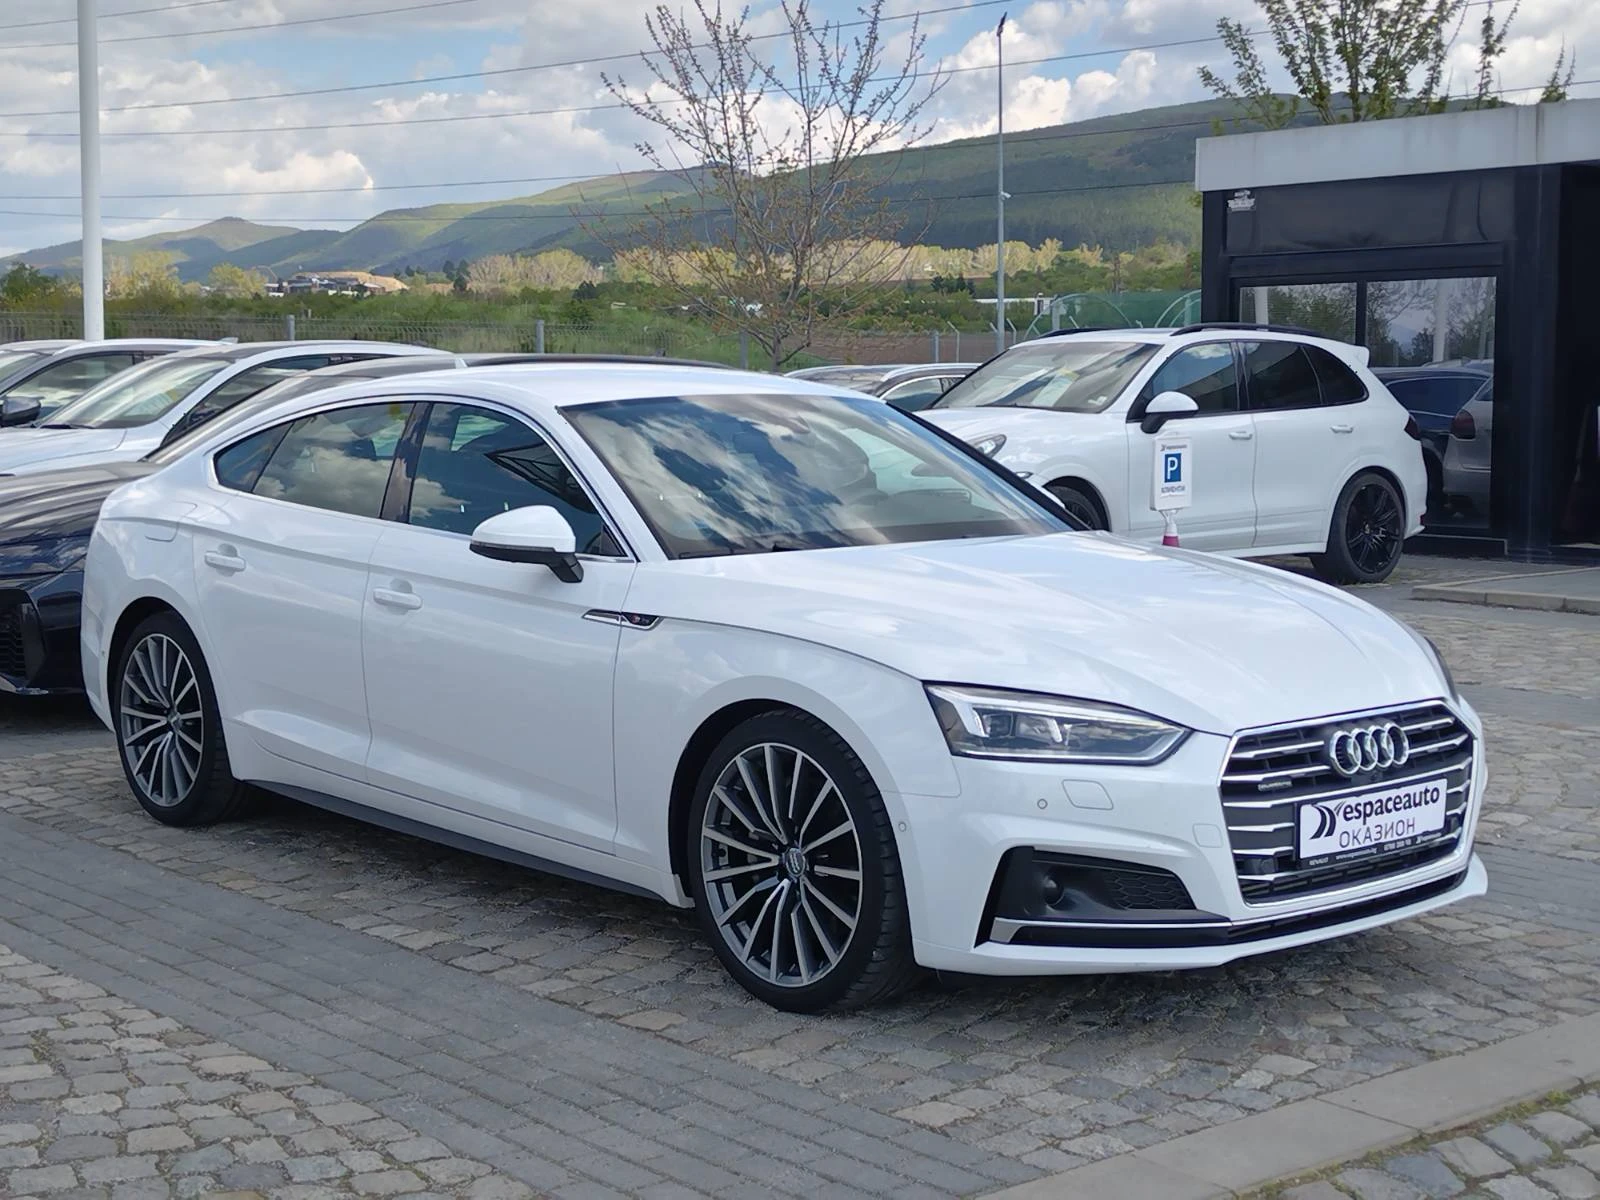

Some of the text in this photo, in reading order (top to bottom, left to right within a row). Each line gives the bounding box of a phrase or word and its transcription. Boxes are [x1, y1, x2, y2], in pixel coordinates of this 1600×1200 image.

[1167, 457, 1178, 480] P
[1343, 786, 1440, 825] espaceauto
[1339, 817, 1416, 849] ОКАЗИОН
